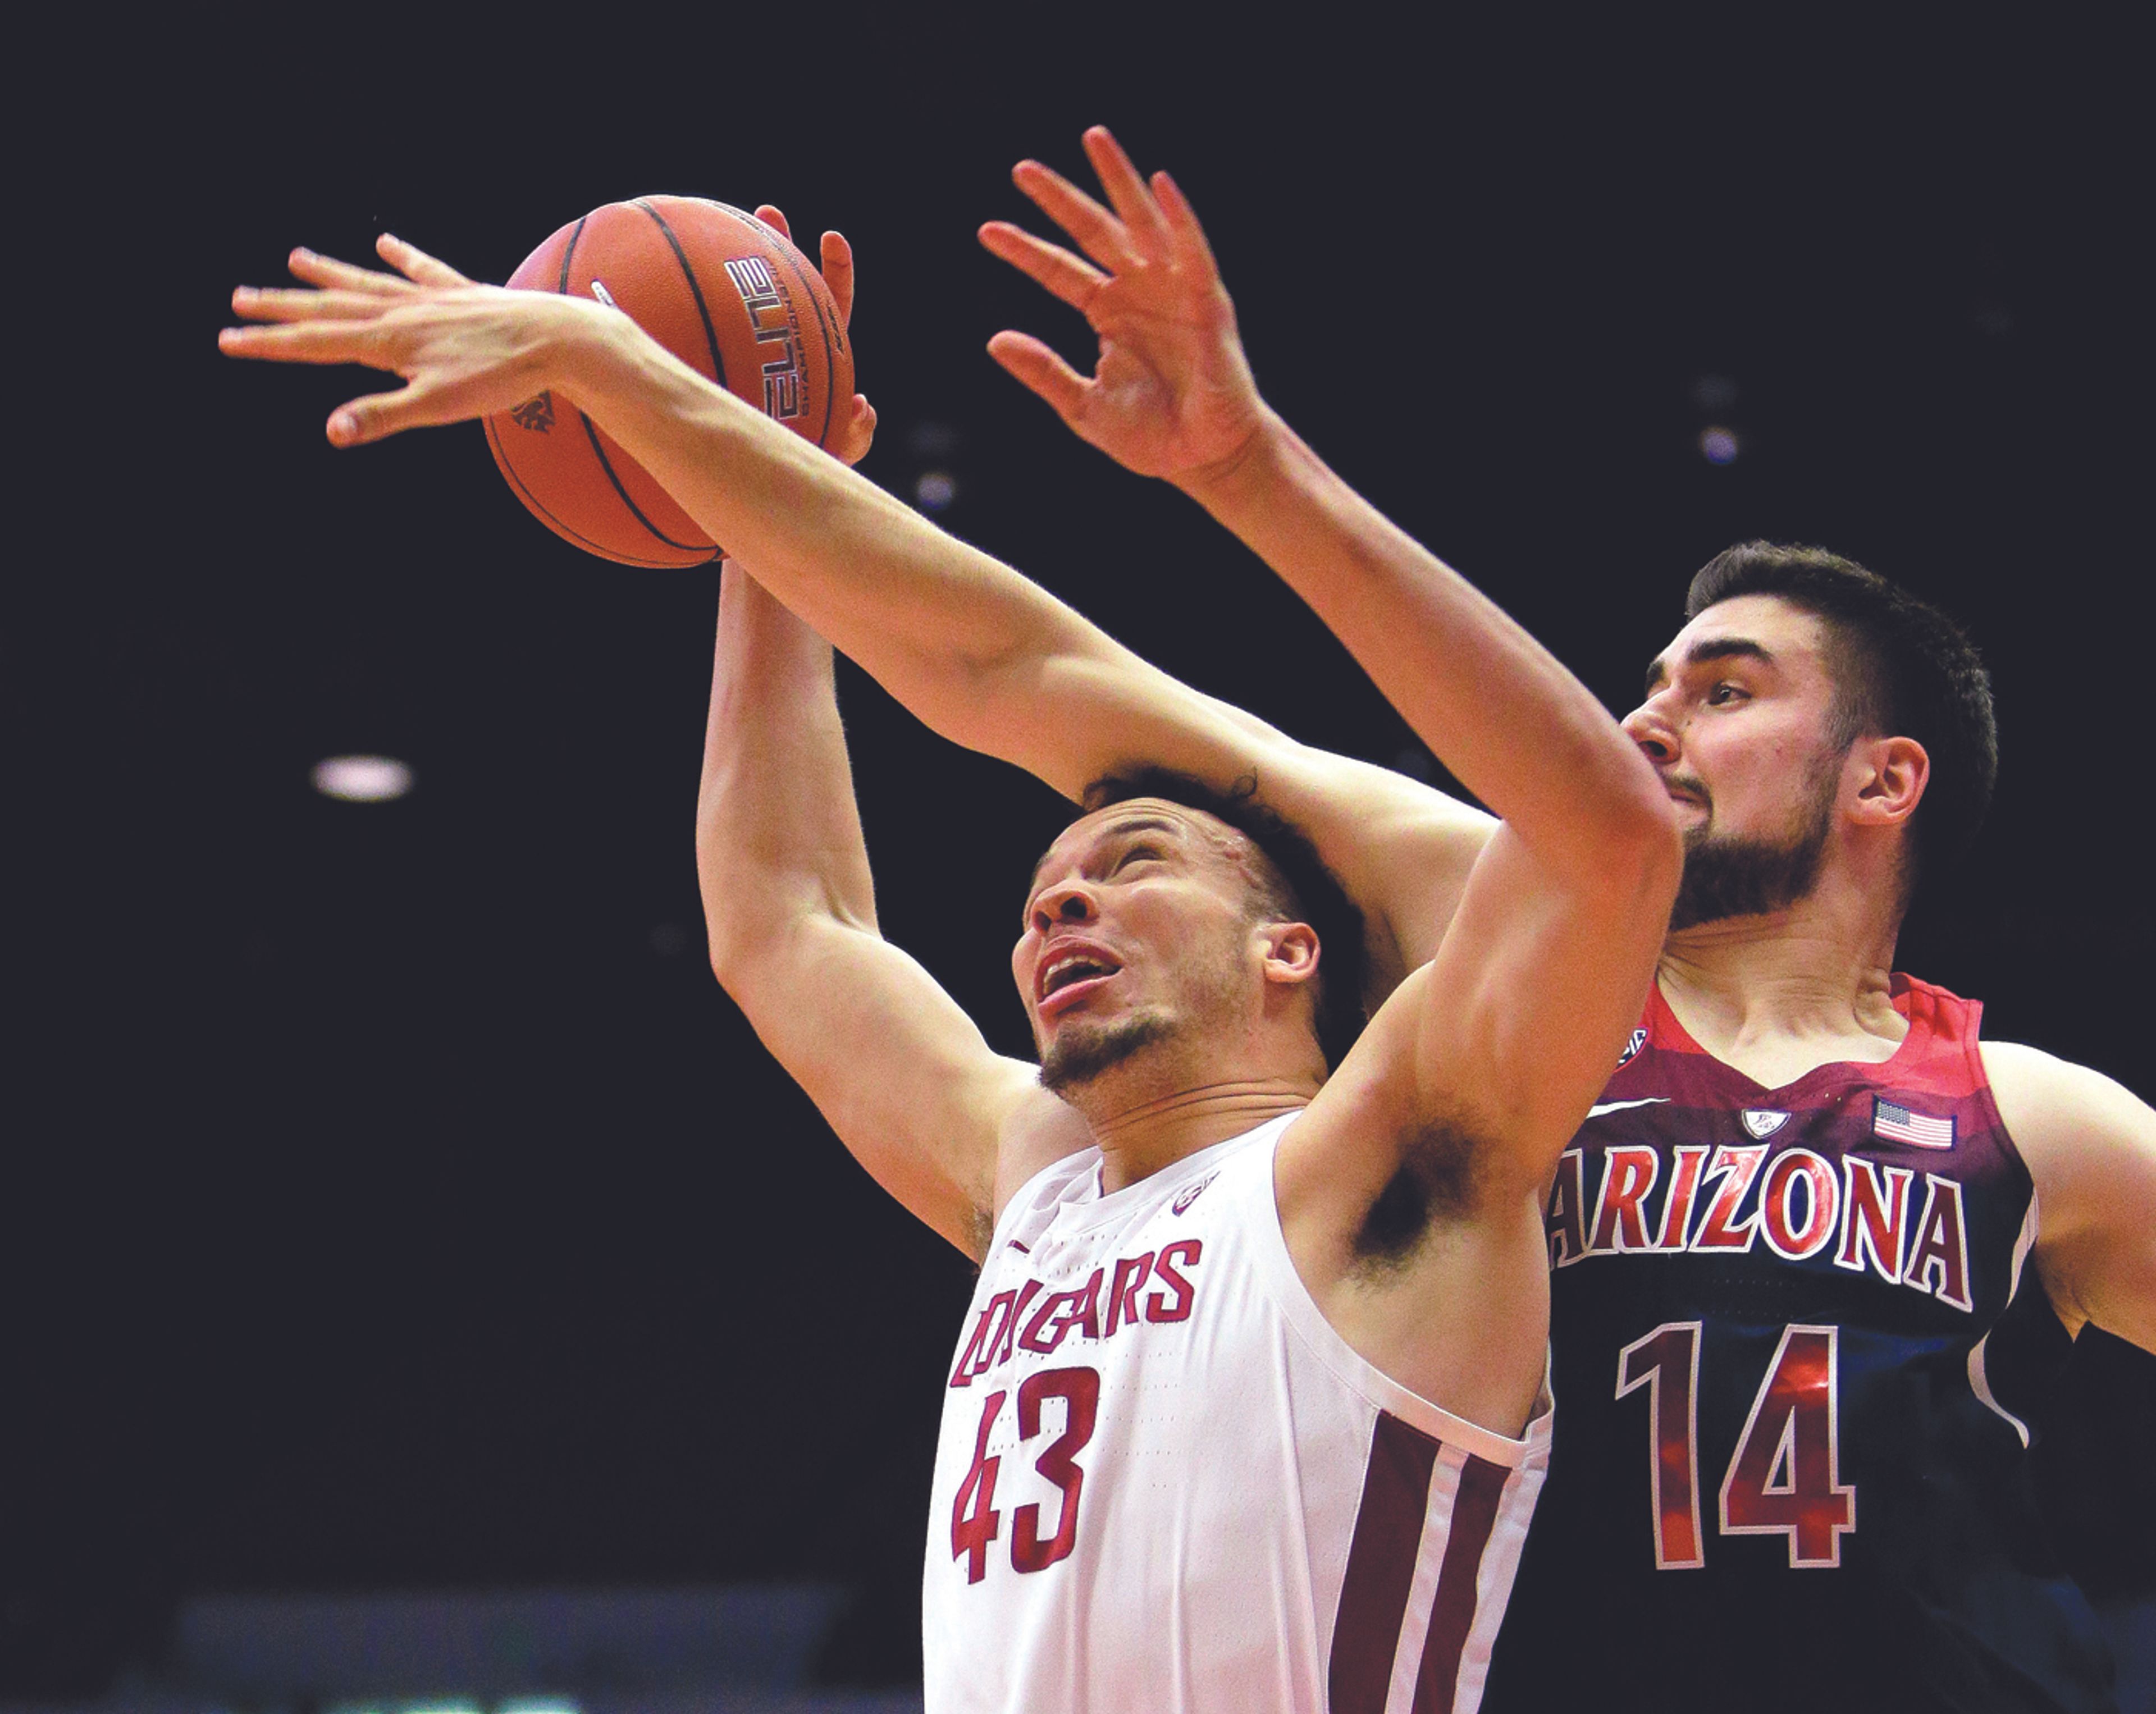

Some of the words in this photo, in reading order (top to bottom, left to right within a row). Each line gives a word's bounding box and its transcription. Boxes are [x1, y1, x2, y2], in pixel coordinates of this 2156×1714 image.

[724, 255, 800, 420] ELITE
[1546, 1144, 1973, 1313] ARIZONA
[951, 1366, 1100, 1584] 43
[1615, 1320, 1856, 1570] 14
